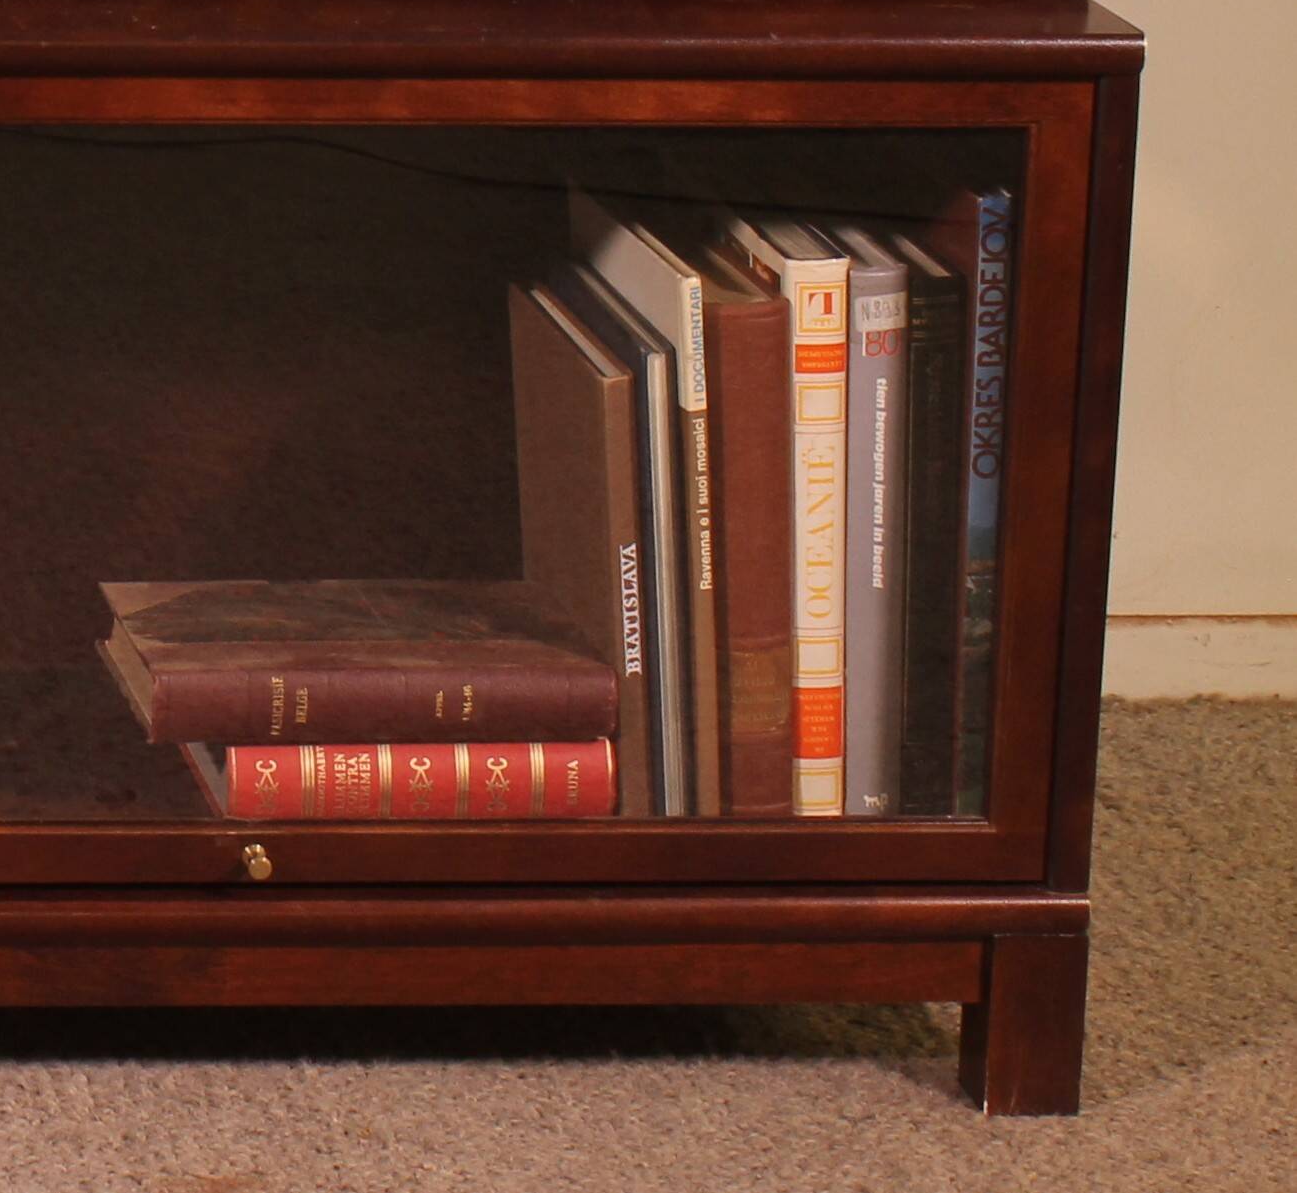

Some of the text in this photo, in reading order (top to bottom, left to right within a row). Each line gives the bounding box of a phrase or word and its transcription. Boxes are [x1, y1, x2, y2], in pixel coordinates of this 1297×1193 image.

[689, 286, 705, 393] DOCUMENTARI
[971, 206, 1009, 479] OKRES BARDEJOV
[693, 418, 707, 472] mosaici
[696, 475, 708, 505] suoi
[871, 377, 887, 590] tien bewogen jaren in beeld
[700, 517, 709, 526] e
[699, 529, 713, 590] Ravenna
[619, 542, 643, 677] BRATISLAVA
[295, 687, 308, 724] BELGE
